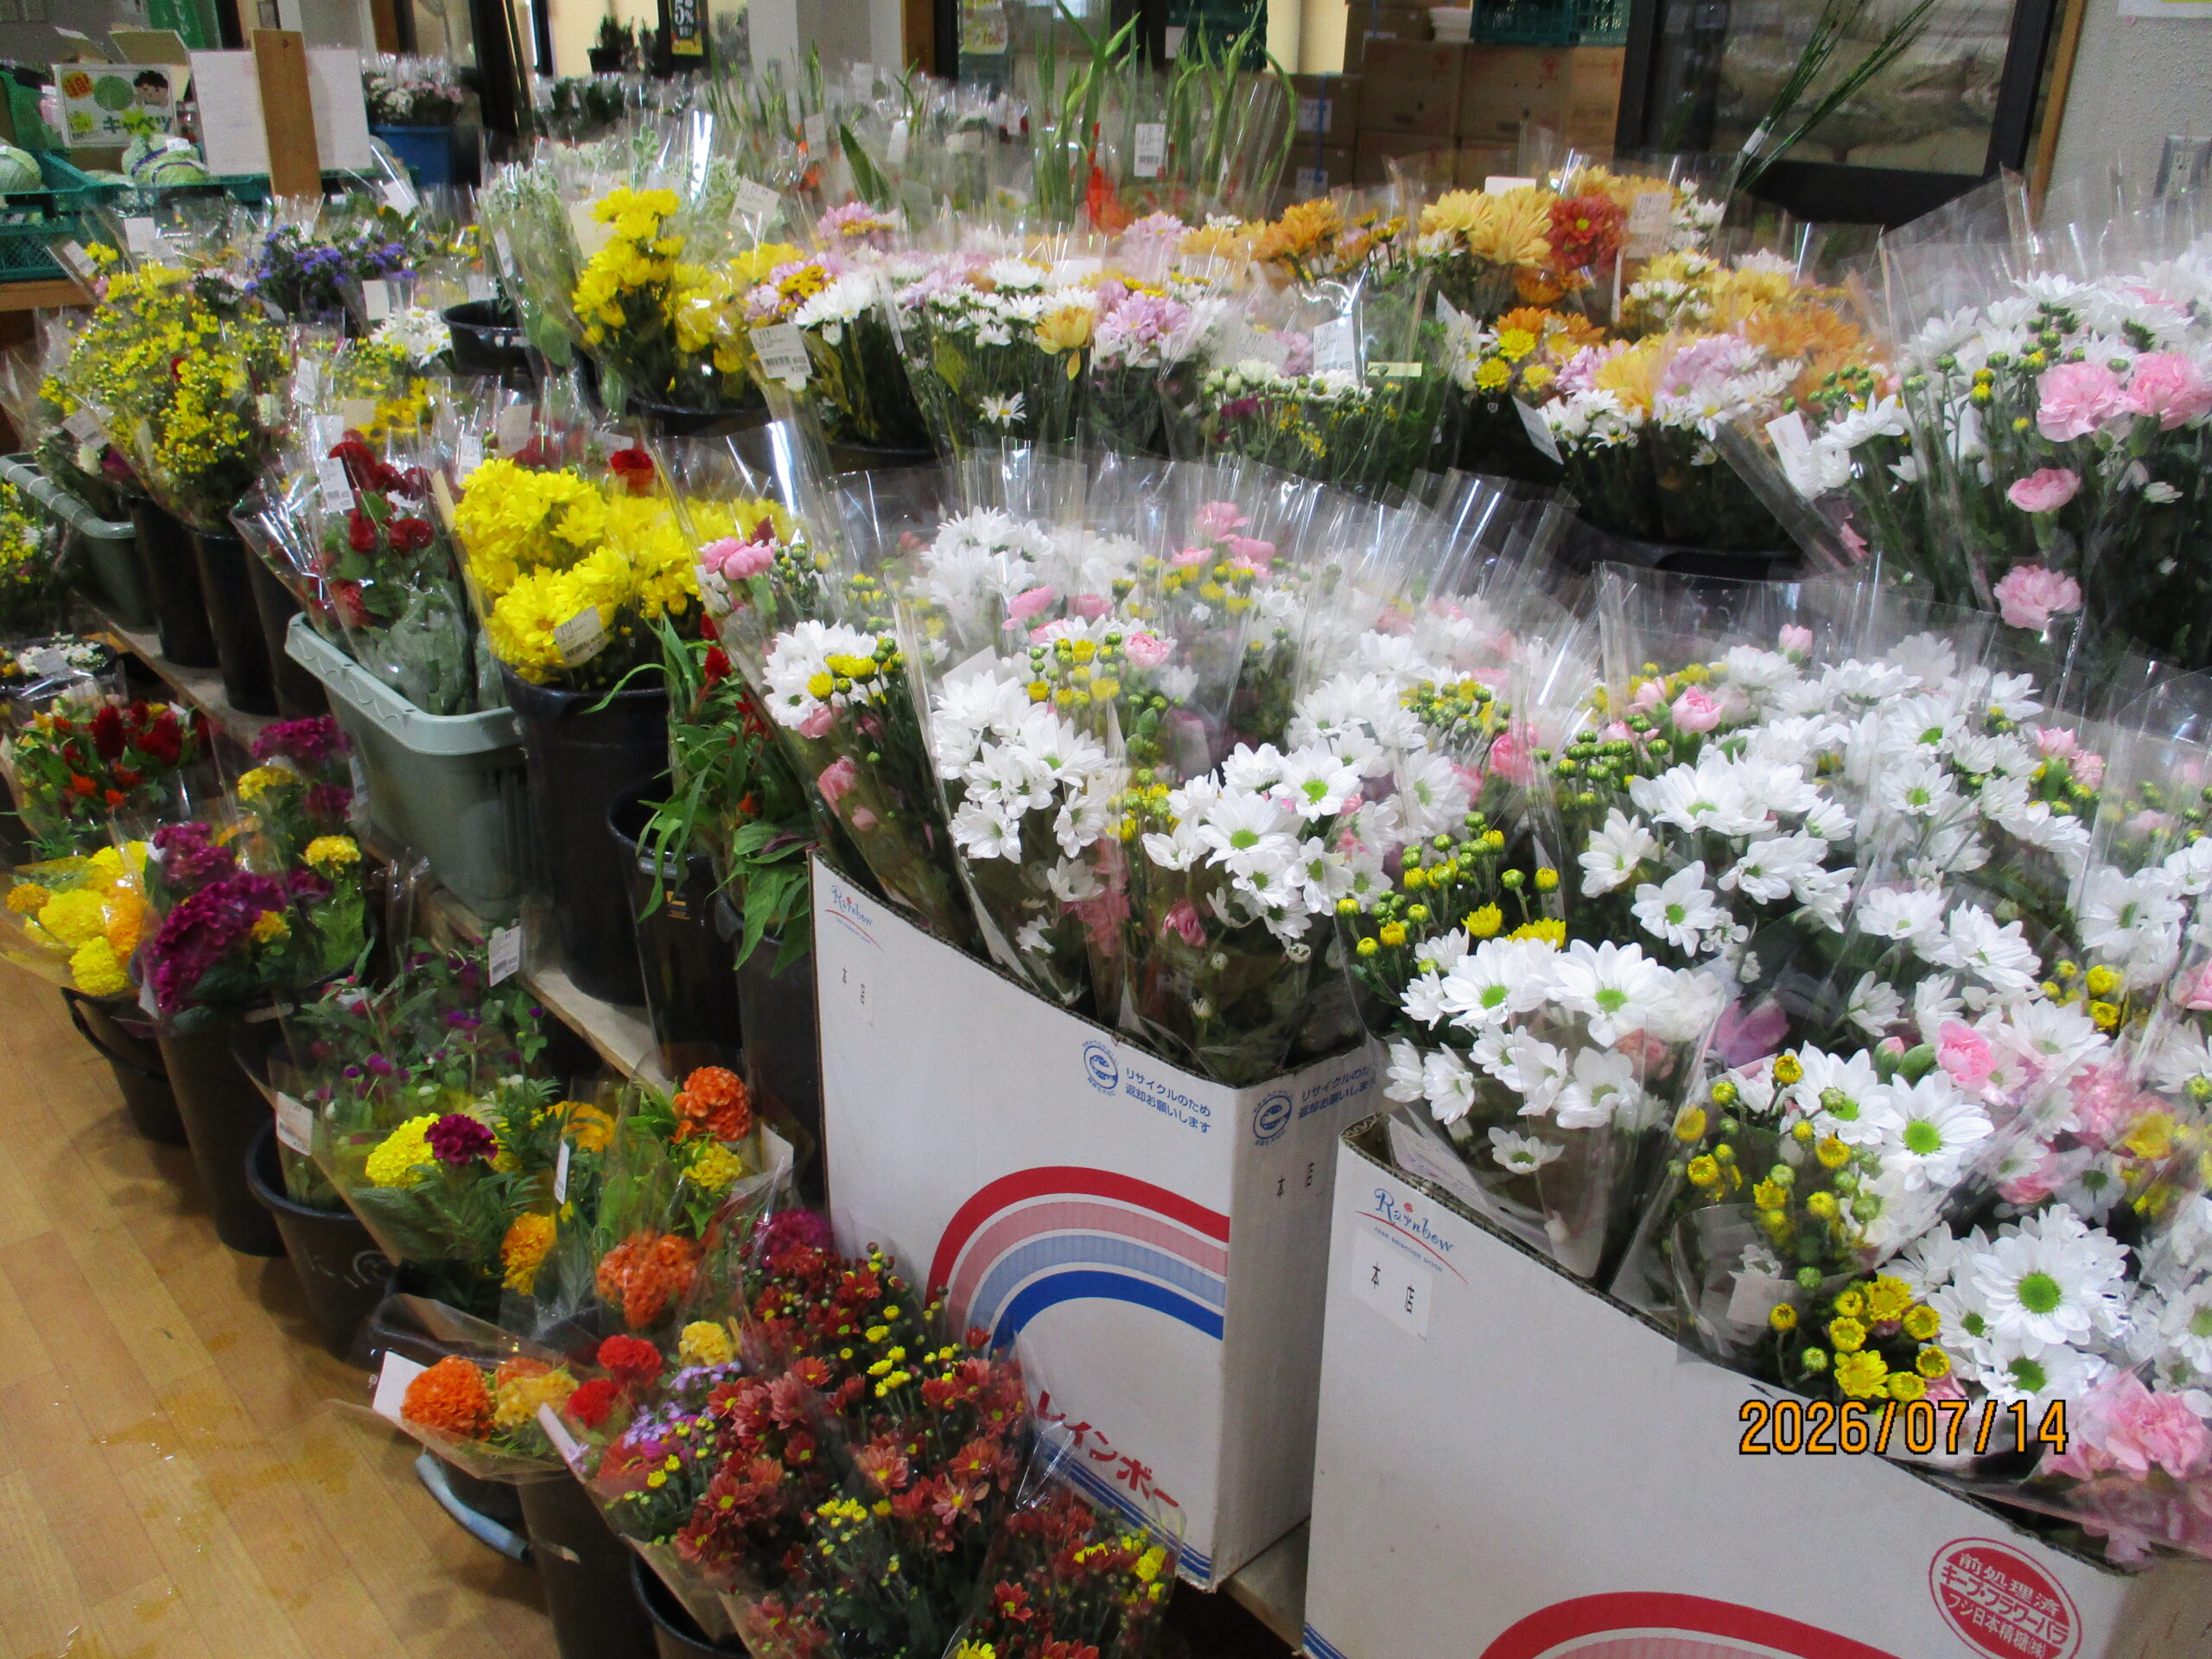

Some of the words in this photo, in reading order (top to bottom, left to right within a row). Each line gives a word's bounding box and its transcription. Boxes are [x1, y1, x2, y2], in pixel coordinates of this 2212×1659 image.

[1125, 1084, 1211, 1134] 返却お願いします
[1126, 1067, 1211, 1117] リサイクルのため
[1298, 1080, 1374, 1120] 返却お願いしま
[1037, 1389, 1180, 1508] レインボー
[1959, 1553, 2062, 1617] 前処理済
